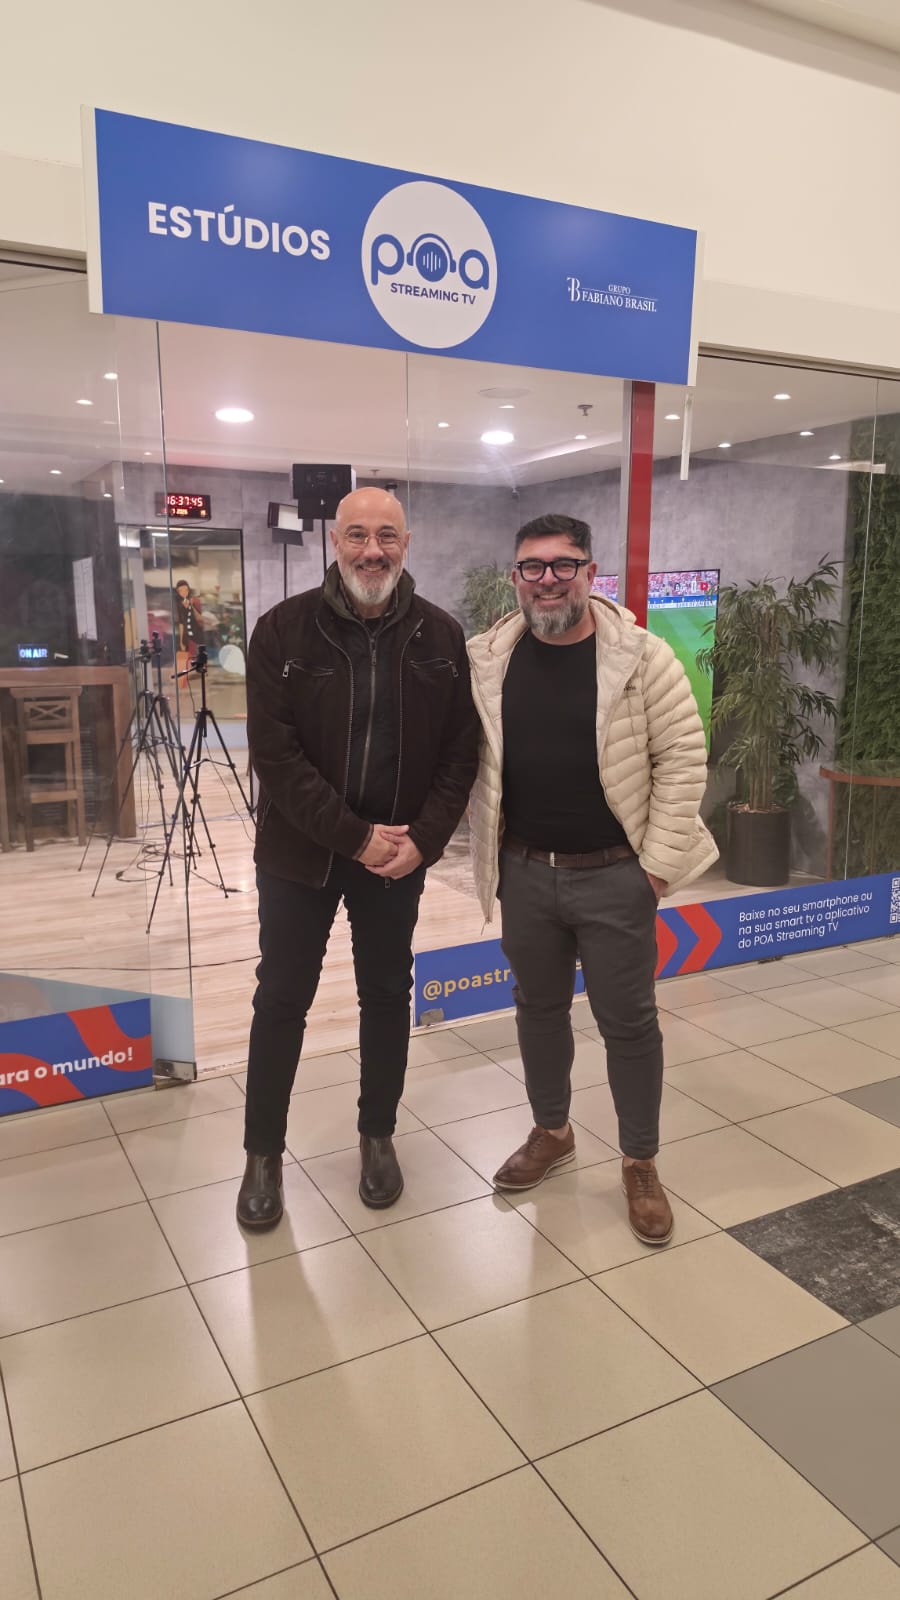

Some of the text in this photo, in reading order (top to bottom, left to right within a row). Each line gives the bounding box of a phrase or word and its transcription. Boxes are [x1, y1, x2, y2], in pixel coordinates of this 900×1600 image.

[148, 201, 331, 260] ESTÚDIOS
[390, 282, 476, 305] STREAMING TV
[582, 291, 657, 312] FABIANO BRASIL
[608, 284, 631, 295] GRUPO
[167, 495, 203, 507] 16:37:45
[20, 648, 32, 658] ON
[738, 905, 870, 936] na sua smart tv o aplicativo
[739, 892, 873, 922] Baixe no seu smartphone ou
[738, 921, 839, 949] do POA Streaming TV
[423, 968, 513, 1000] @poastr
[34, 1066, 48, 1079] o
[52, 1046, 133, 1076] mundo!
